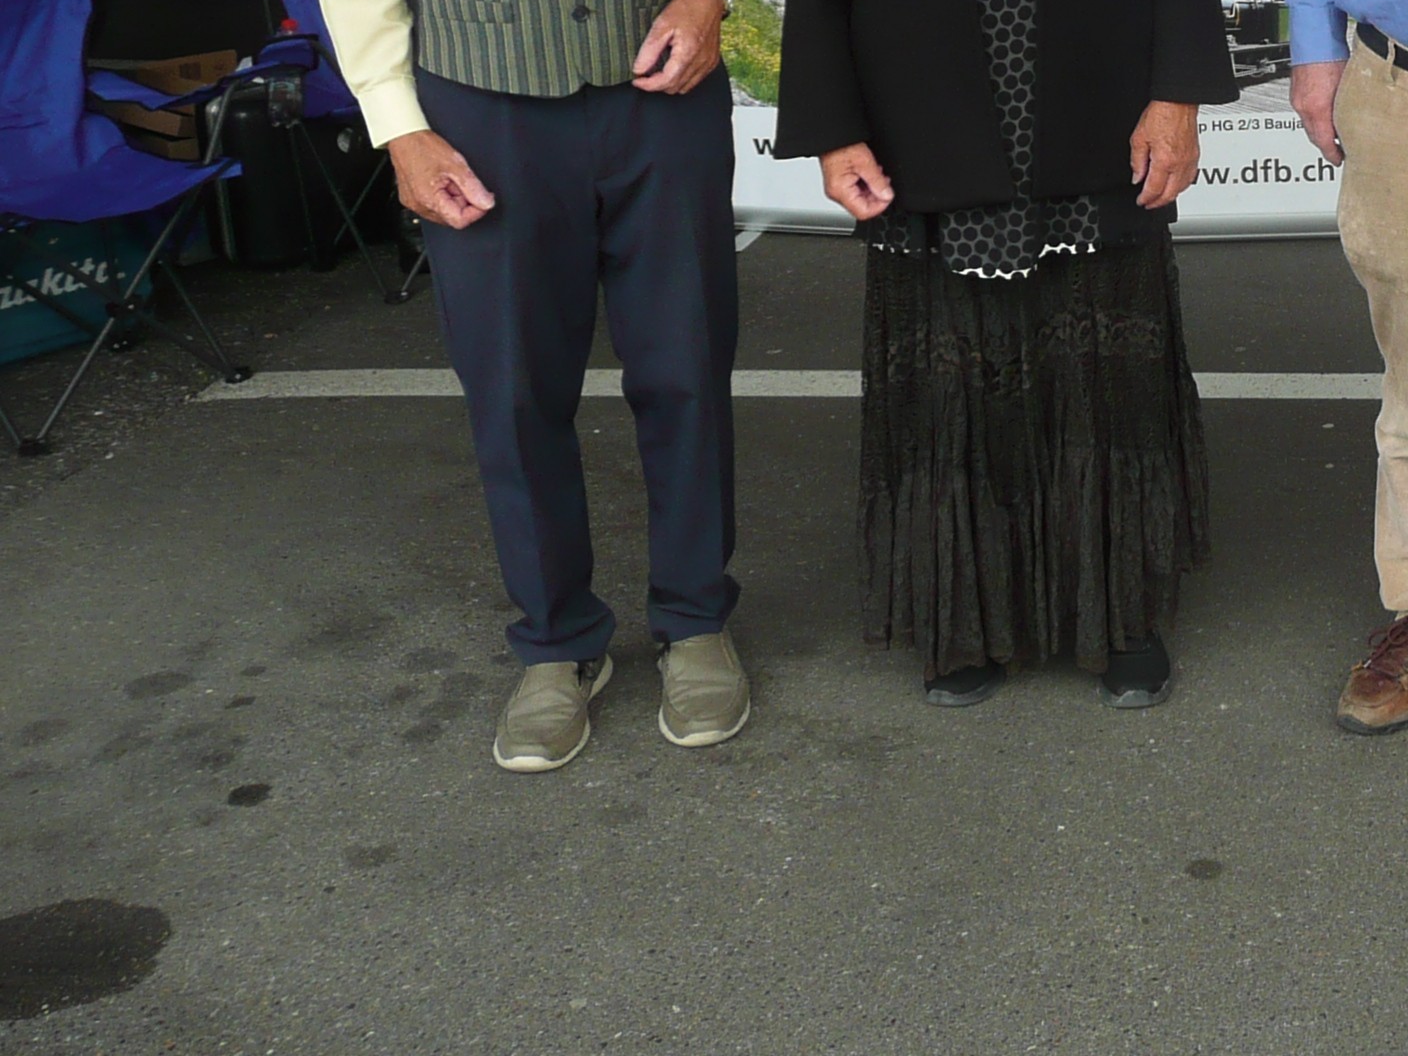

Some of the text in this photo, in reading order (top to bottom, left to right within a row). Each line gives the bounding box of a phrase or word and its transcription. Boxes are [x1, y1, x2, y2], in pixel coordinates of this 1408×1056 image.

[1212, 119, 1233, 131] HG
[1238, 118, 1260, 131] 2/3
[1264, 118, 1304, 132] Bauja
[1191, 157, 1335, 185] w.dfb.ch
